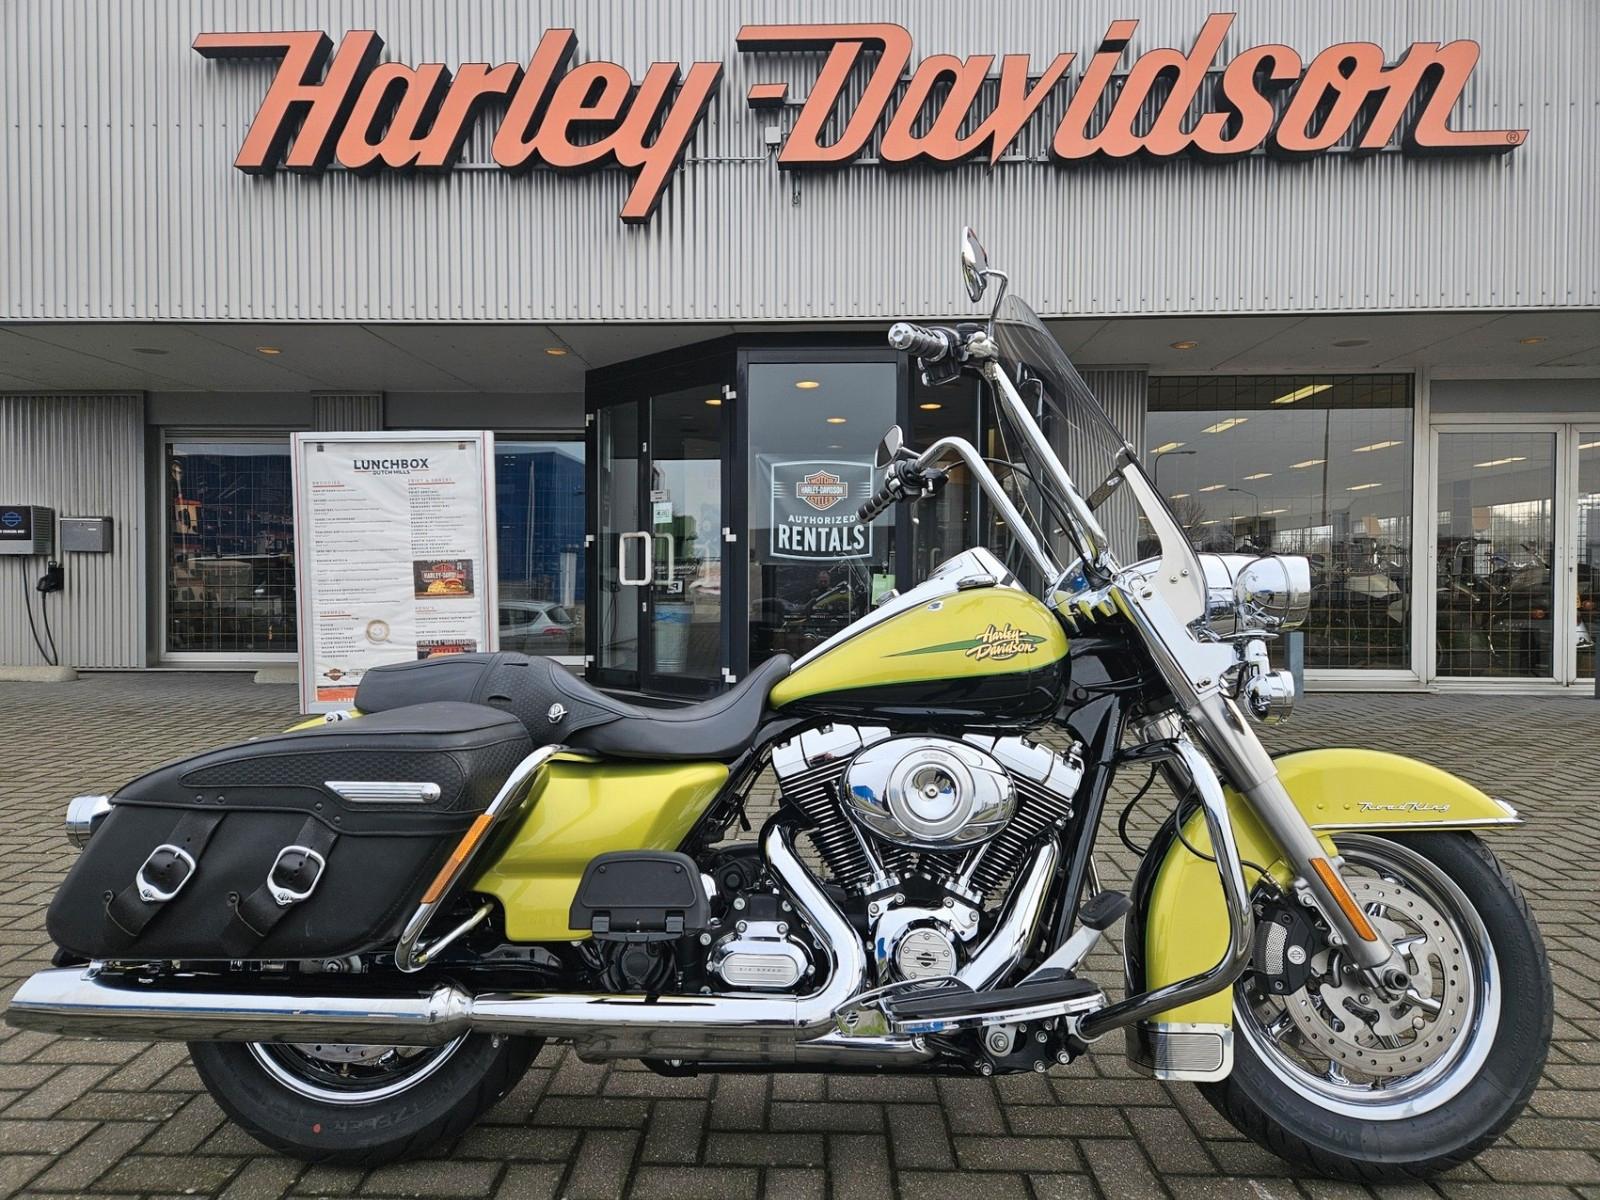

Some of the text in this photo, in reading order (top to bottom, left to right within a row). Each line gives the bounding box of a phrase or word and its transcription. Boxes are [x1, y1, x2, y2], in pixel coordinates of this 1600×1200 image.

[353, 458, 430, 470] LUNCHBOX
[788, 514, 856, 525] AUTHORIZED
[778, 523, 865, 552] RENTALS
[965, 641, 1038, 661] Davidson
